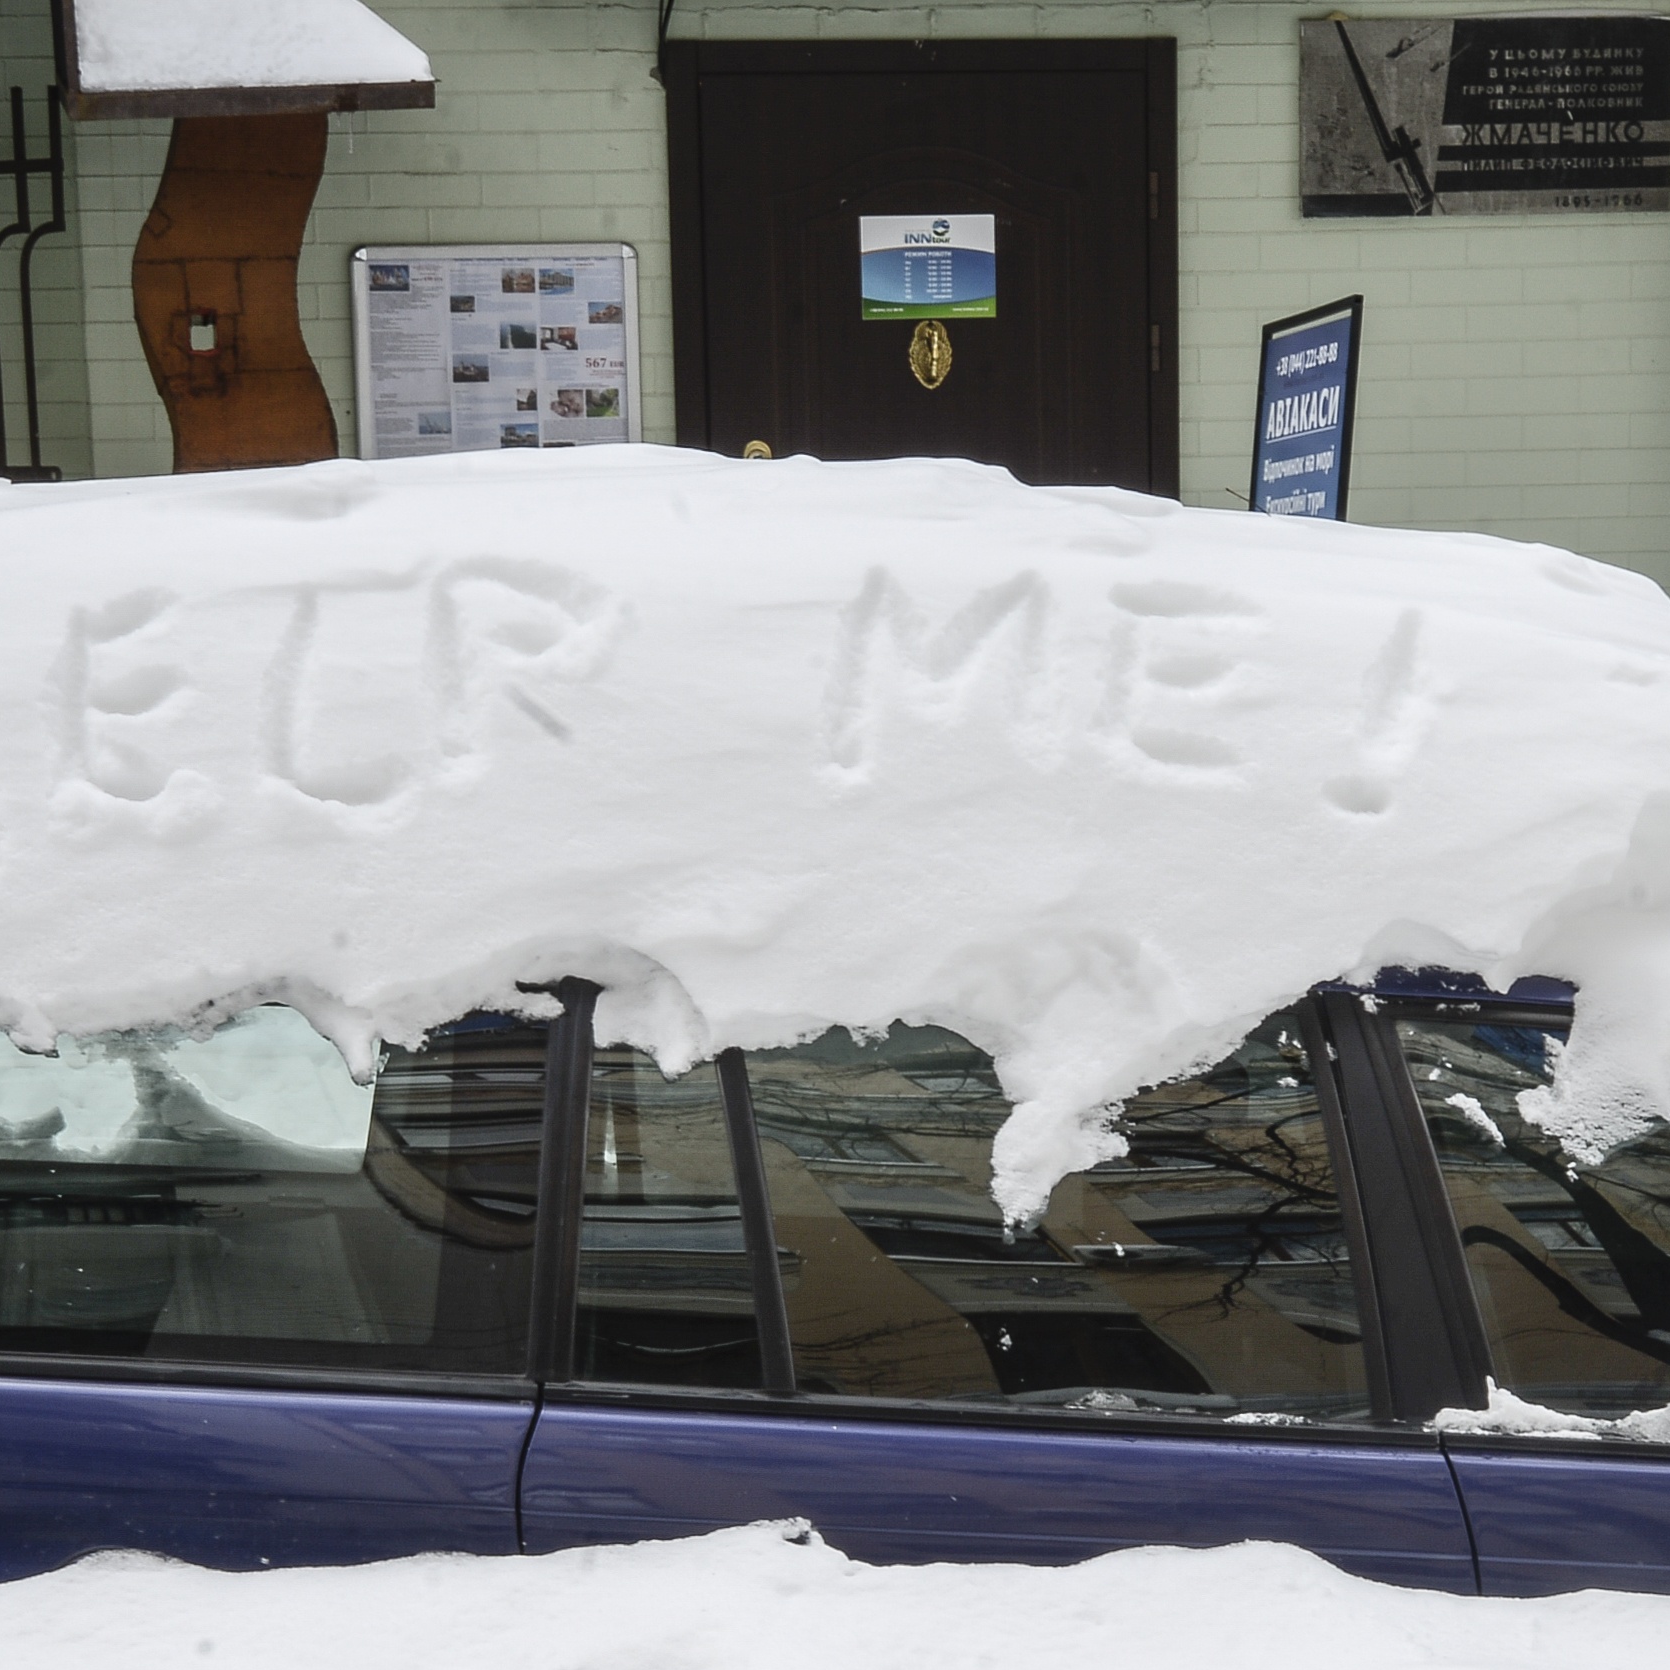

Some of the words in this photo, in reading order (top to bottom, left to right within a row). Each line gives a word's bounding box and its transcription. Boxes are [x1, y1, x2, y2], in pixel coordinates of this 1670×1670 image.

[1504, 49, 1567, 61] ЦЬОМУ
[1572, 48, 1644, 59] БУДИНКУ
[1489, 67, 1498, 78] В
[1610, 65, 1644, 76] ЖИВ
[1463, 84, 1504, 95] ГЕРОЙ
[1509, 83, 1598, 95] РАДЯНСЬКОГО
[1462, 121, 1645, 146] ЖМАЧЕНКО
[586, 357, 607, 368] 567
[1266, 385, 1340, 440] АВІАКАСИ
[1304, 454, 1315, 473] на
[1315, 445, 1335, 475] морі
